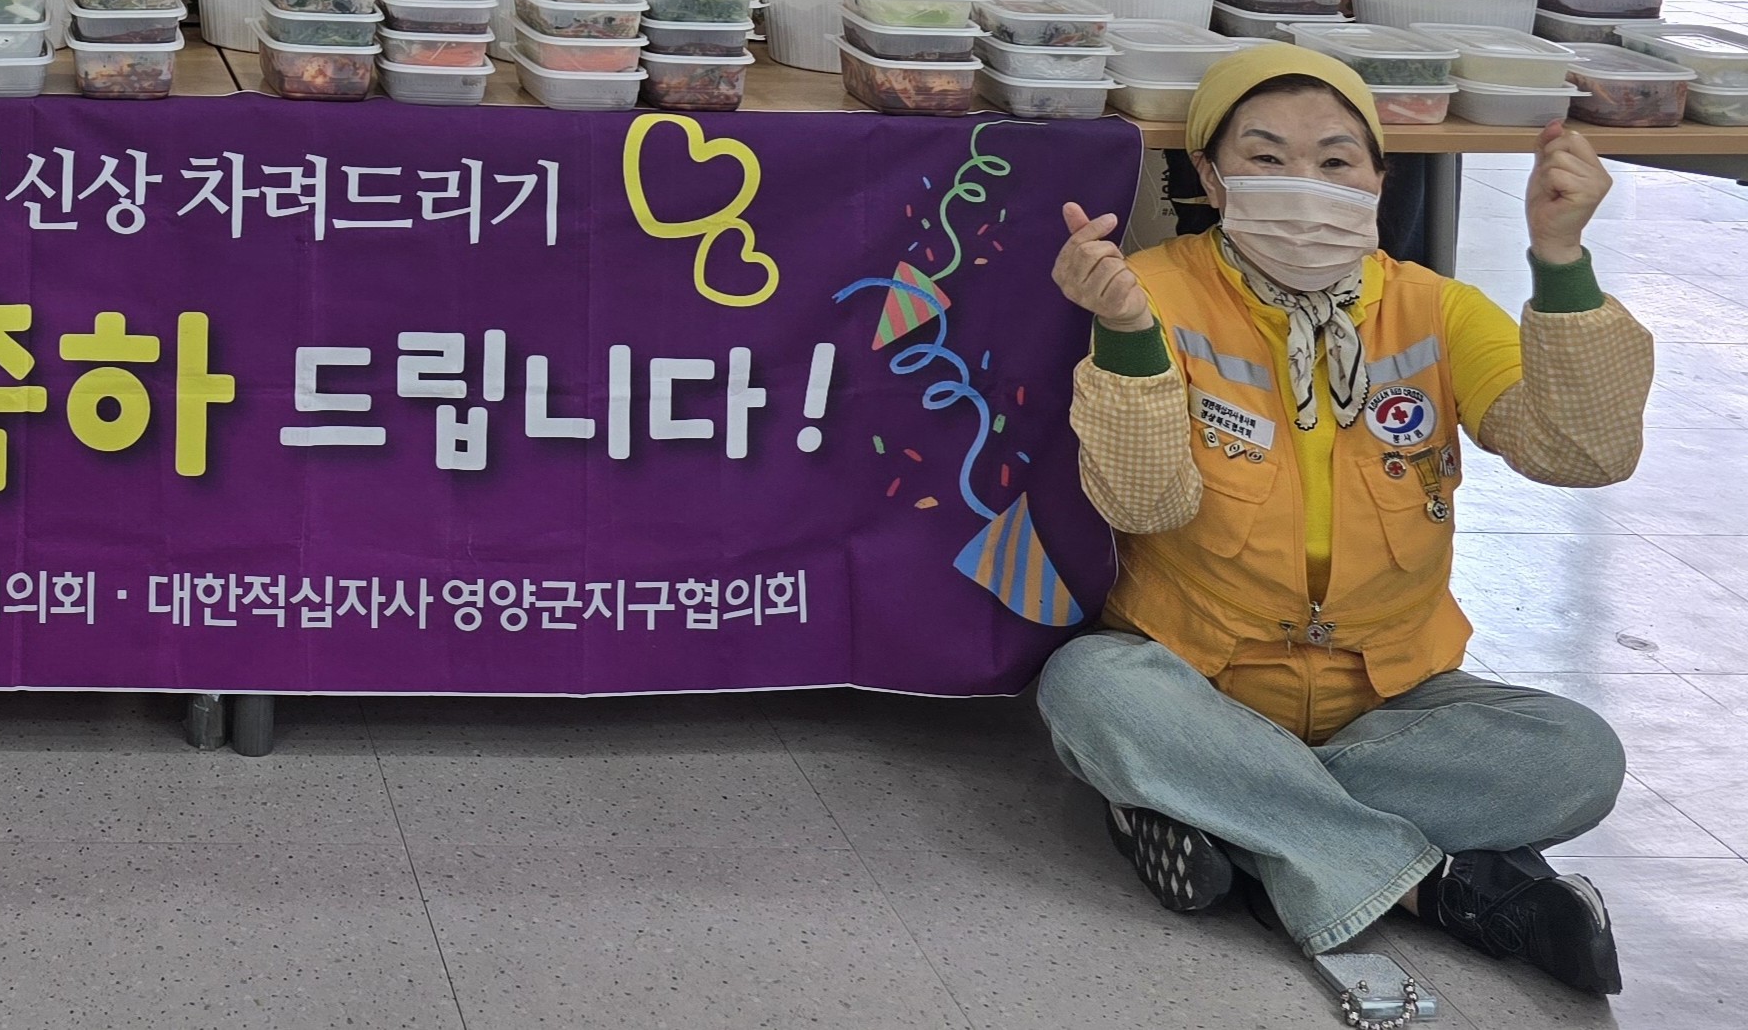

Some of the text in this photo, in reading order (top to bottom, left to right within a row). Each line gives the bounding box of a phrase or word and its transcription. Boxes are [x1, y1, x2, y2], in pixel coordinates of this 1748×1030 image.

[177, 152, 558, 245] 차려드리기
[148, 572, 433, 629] 대한적십자사
[442, 570, 807, 631] 영양군지구협의회
